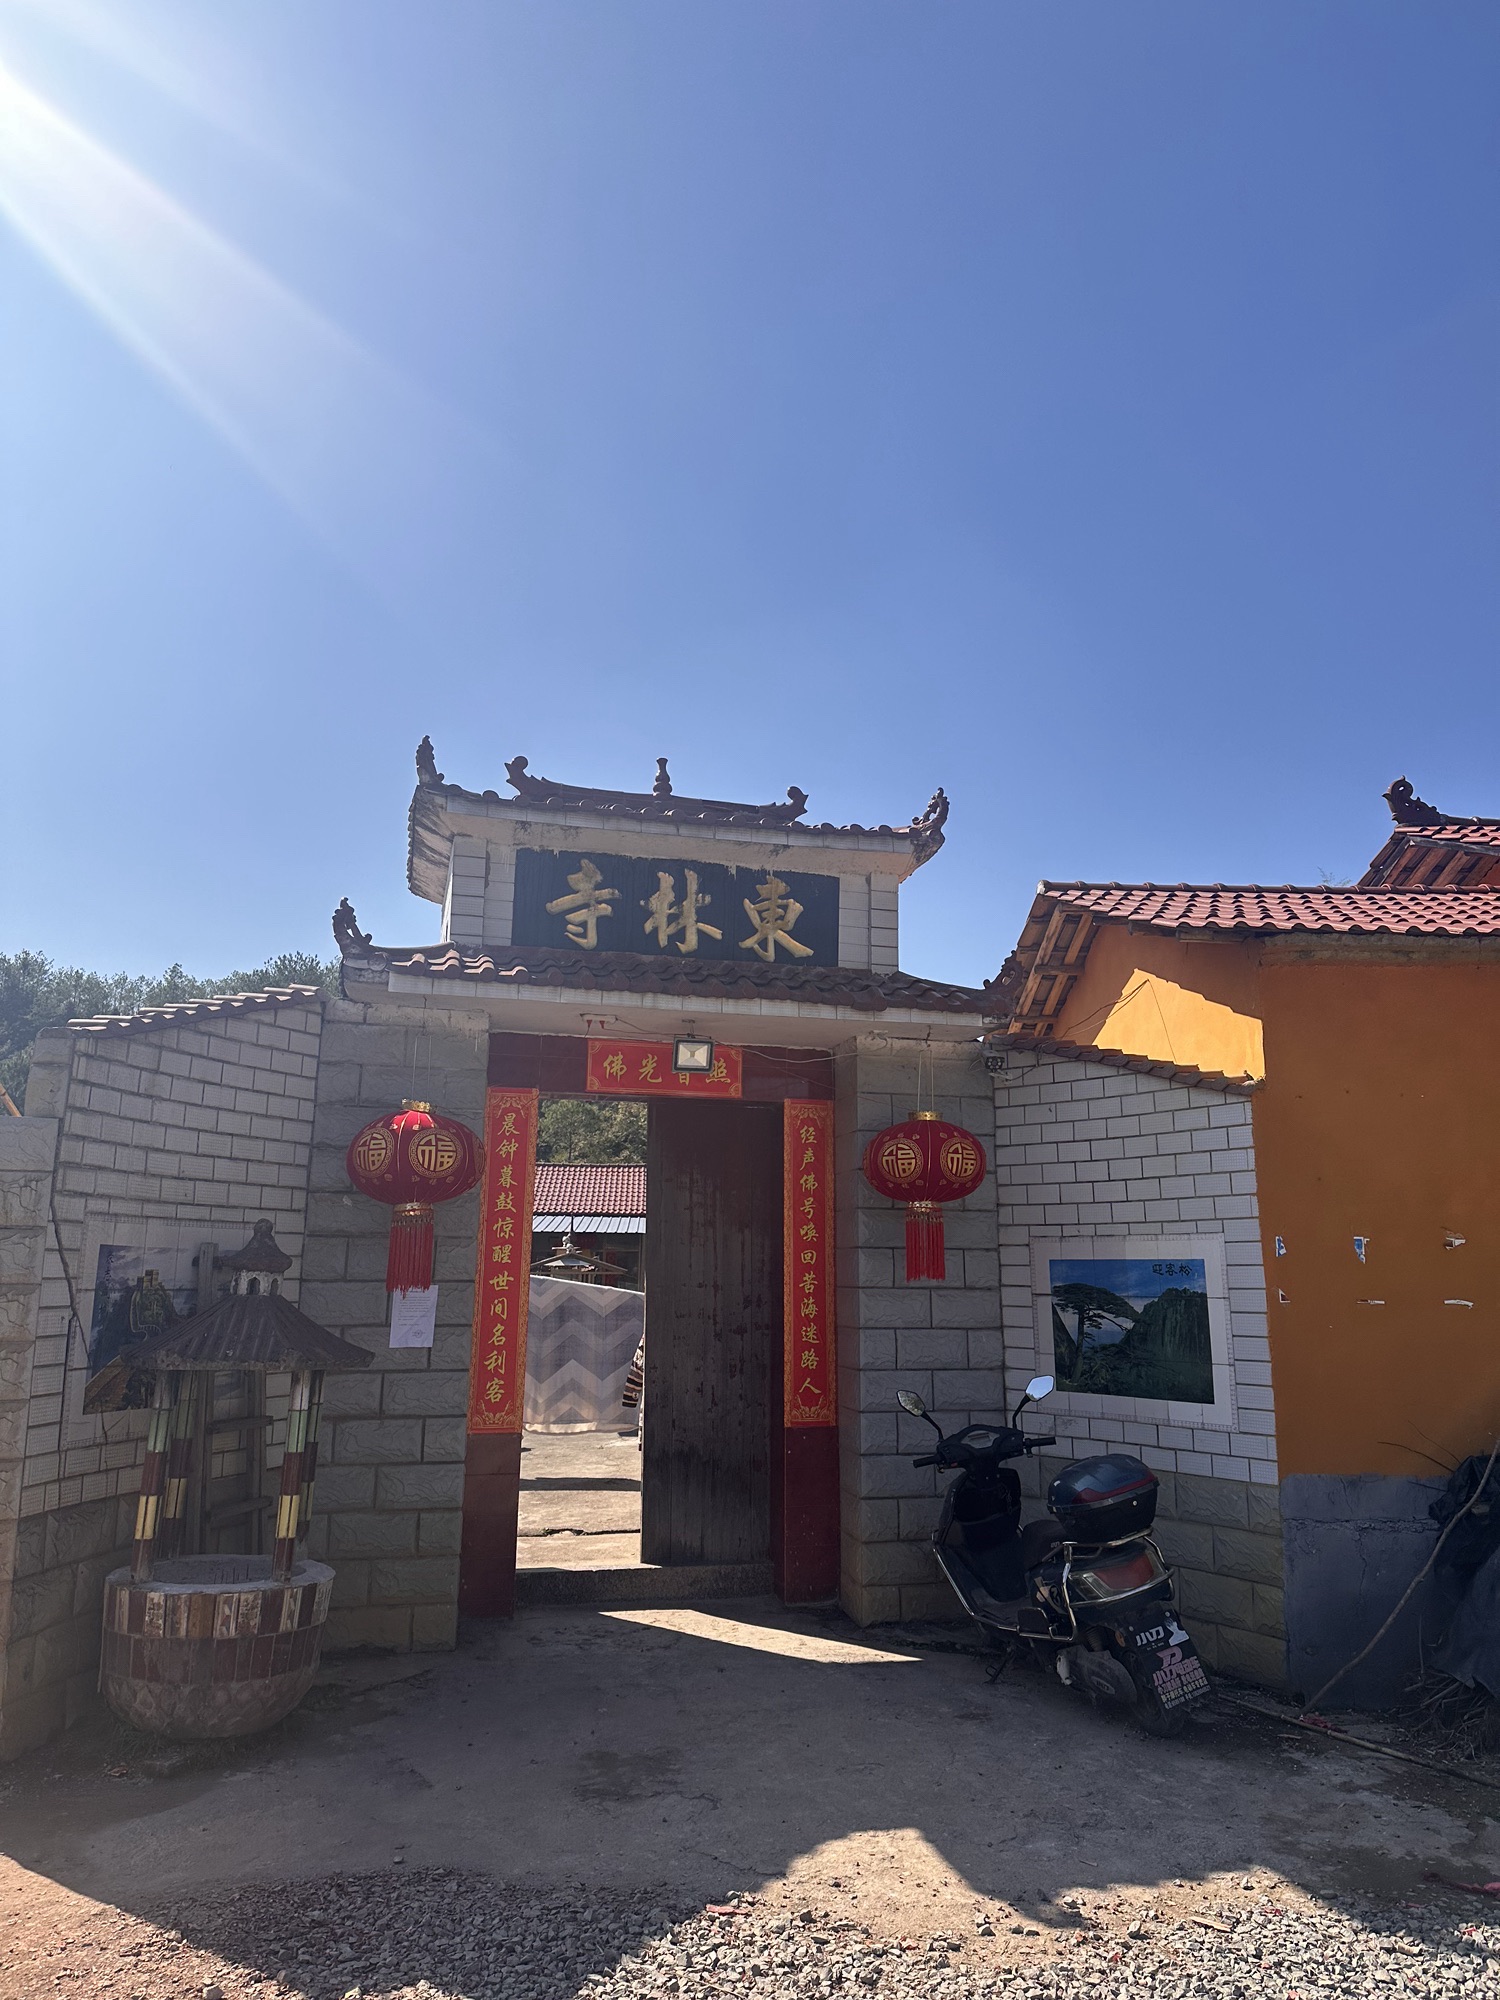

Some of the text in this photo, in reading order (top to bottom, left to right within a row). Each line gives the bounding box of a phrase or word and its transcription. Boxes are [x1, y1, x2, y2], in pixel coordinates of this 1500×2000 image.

[357, 1133, 387, 1171] 福
[417, 1134, 457, 1172] 福
[882, 1143, 916, 1178] 福
[947, 1142, 977, 1178] 福
[483, 1112, 520, 1404] 晨钟暮鼓惊醒世间名利客
[799, 1125, 822, 1394] 经声佛号唤回苦海迷路人
[1152, 1262, 1192, 1277] 迎客松
